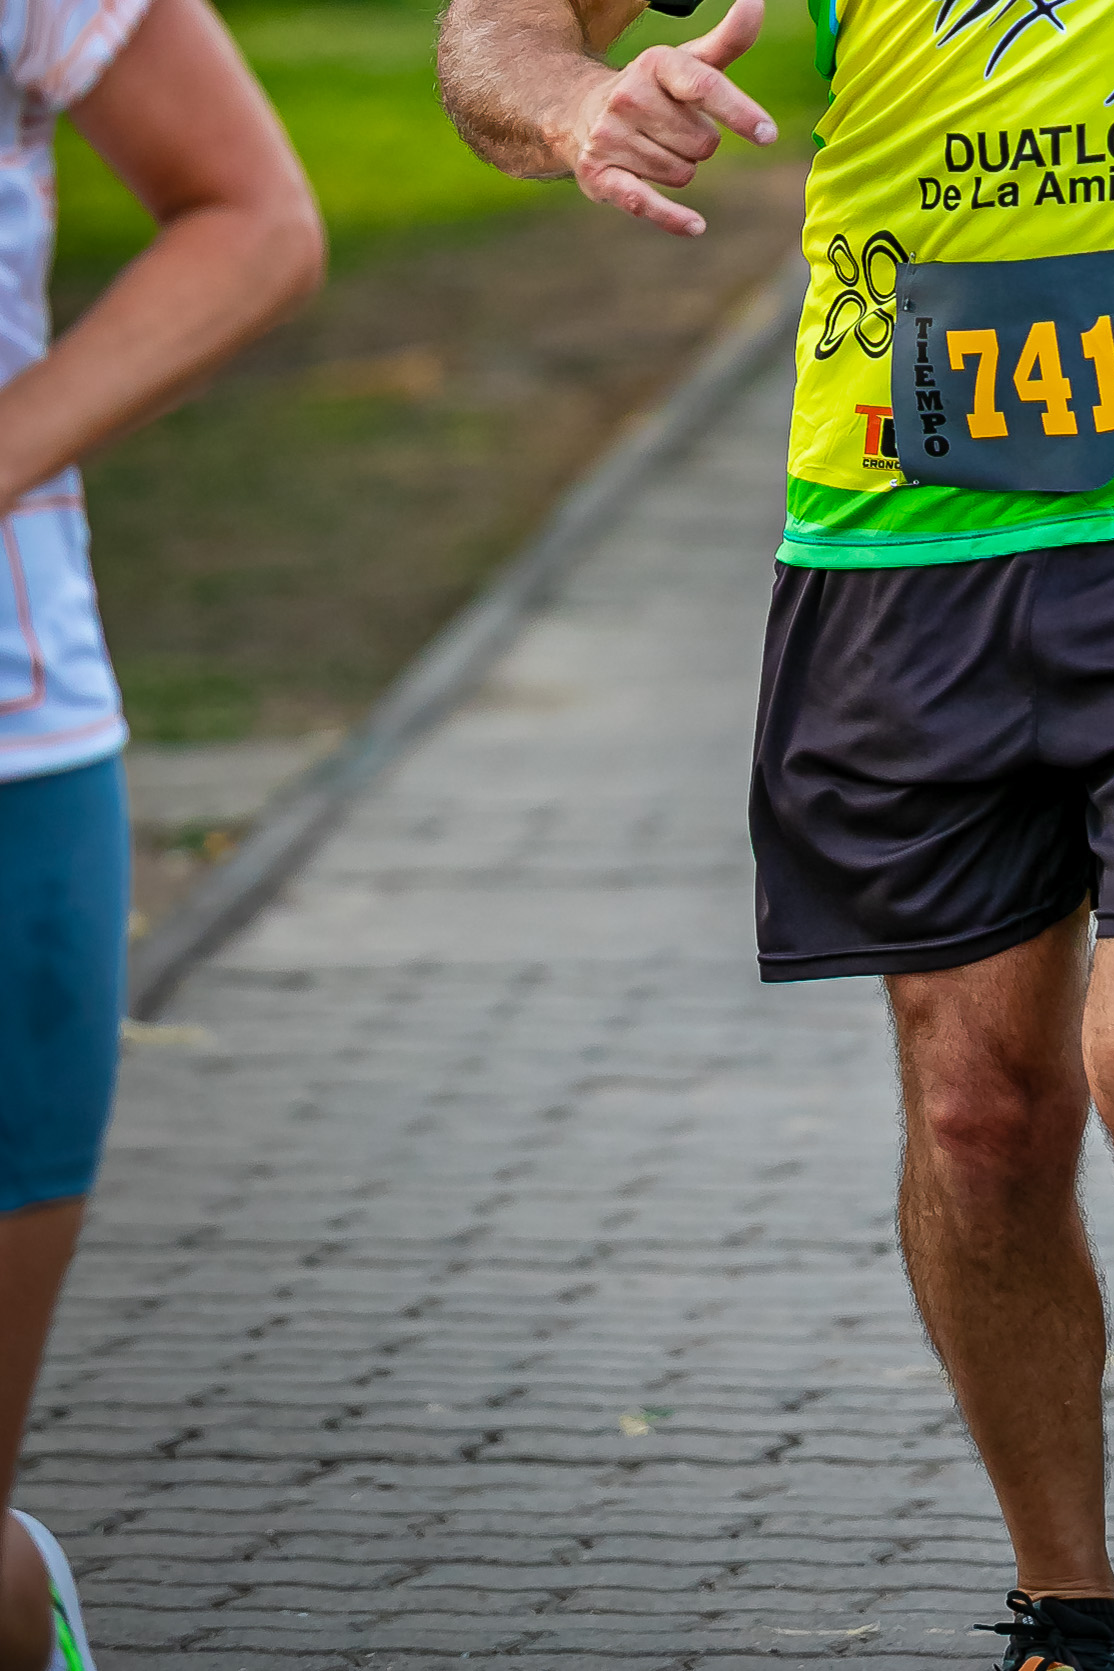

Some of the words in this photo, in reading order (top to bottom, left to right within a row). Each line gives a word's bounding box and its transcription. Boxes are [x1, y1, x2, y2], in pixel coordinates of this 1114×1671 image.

[918, 177, 962, 211] De
[971, 177, 1019, 210] La
[913, 317, 950, 458] TIEMPO
